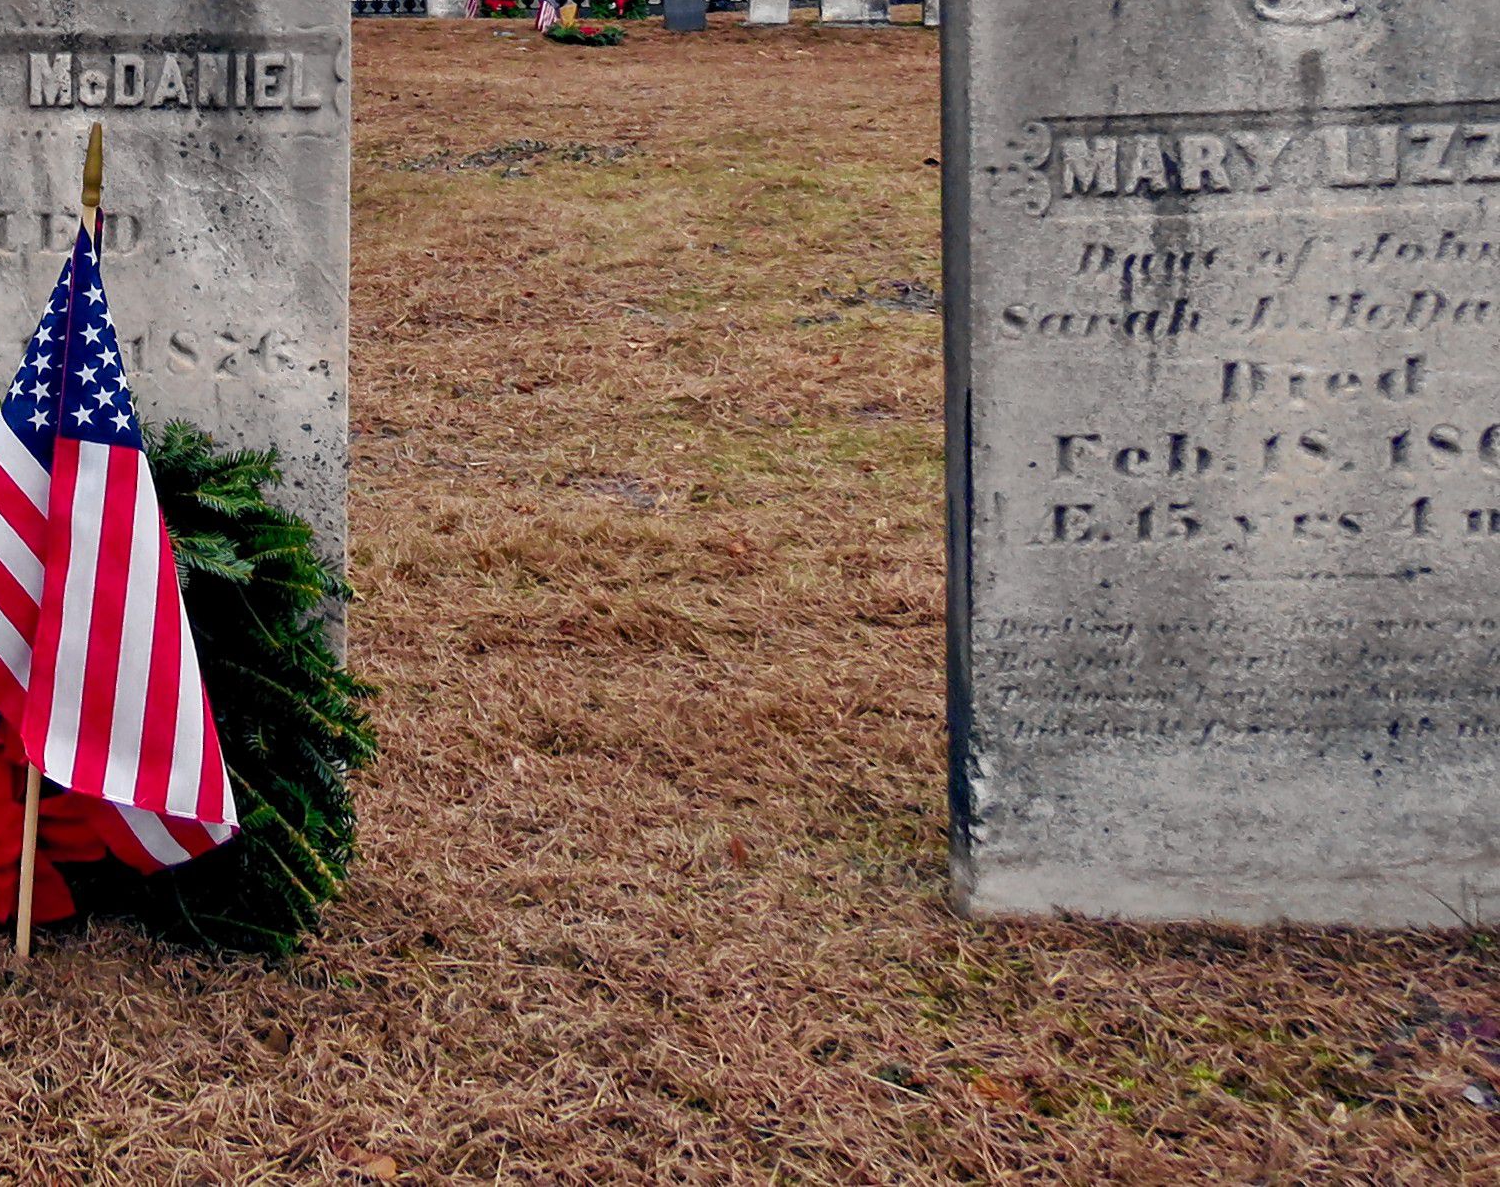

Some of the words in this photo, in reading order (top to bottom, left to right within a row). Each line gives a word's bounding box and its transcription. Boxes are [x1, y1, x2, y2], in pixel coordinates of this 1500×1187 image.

[28, 50, 321, 110] McDANIEL
[1060, 133, 1296, 197] MARY
[1002, 298, 1203, 340] Sarah
[1219, 352, 1424, 404] Died
[1052, 431, 1238, 479] Feb.
